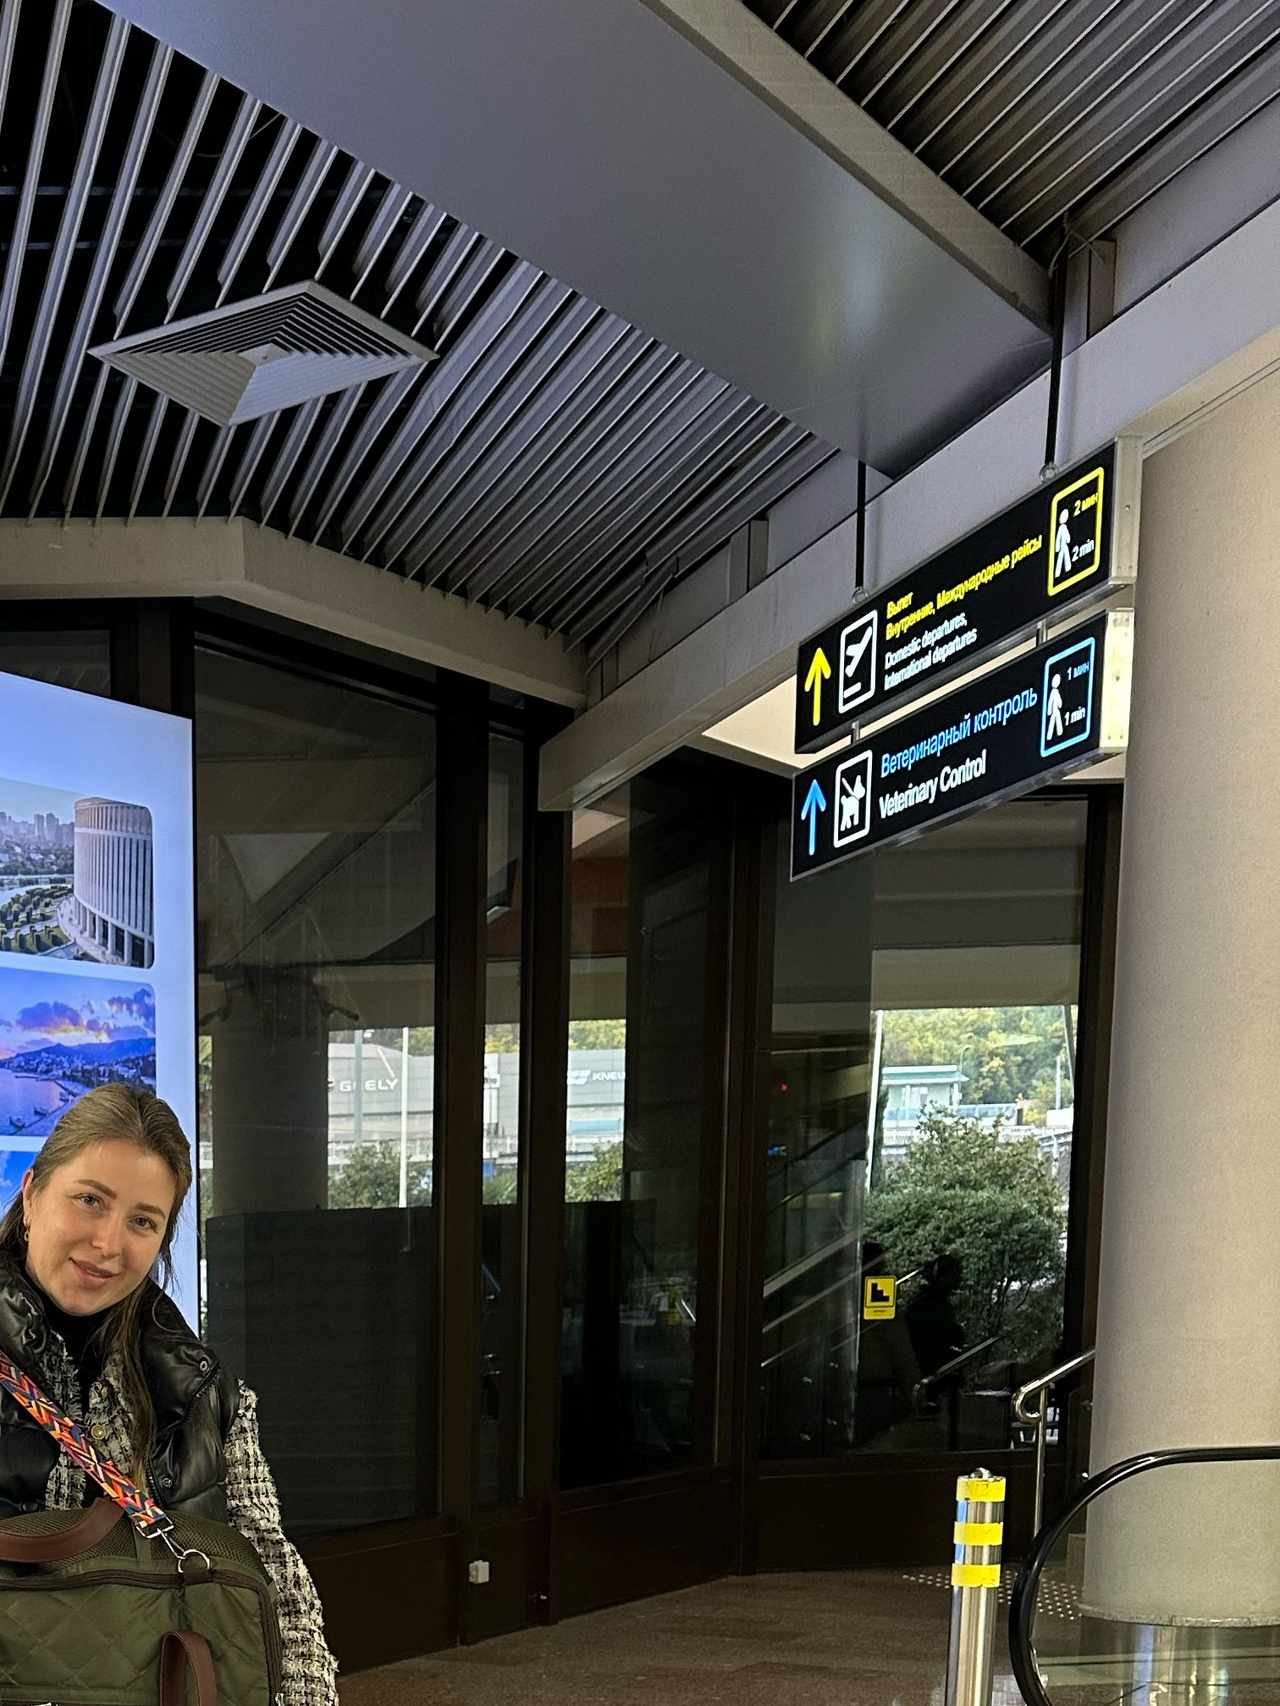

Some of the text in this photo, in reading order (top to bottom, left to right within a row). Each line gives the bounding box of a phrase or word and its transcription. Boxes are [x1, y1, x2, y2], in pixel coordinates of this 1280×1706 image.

[1073, 499, 1081, 517] 2
[1072, 538, 1095, 562] 2 min
[936, 555, 1010, 609] Международные
[1010, 534, 1043, 569] рейсы
[886, 592, 914, 619] Вылет
[884, 612, 968, 670] Domestic departures,
[884, 628, 978, 690] International departures
[1066, 666, 1072, 680] 1
[1064, 706, 1086, 726] 1 min
[880, 687, 1038, 778] Ветеринарный контроль
[878, 748, 987, 819] Veterinary Control
[339, 1078, 399, 1092] GELY
